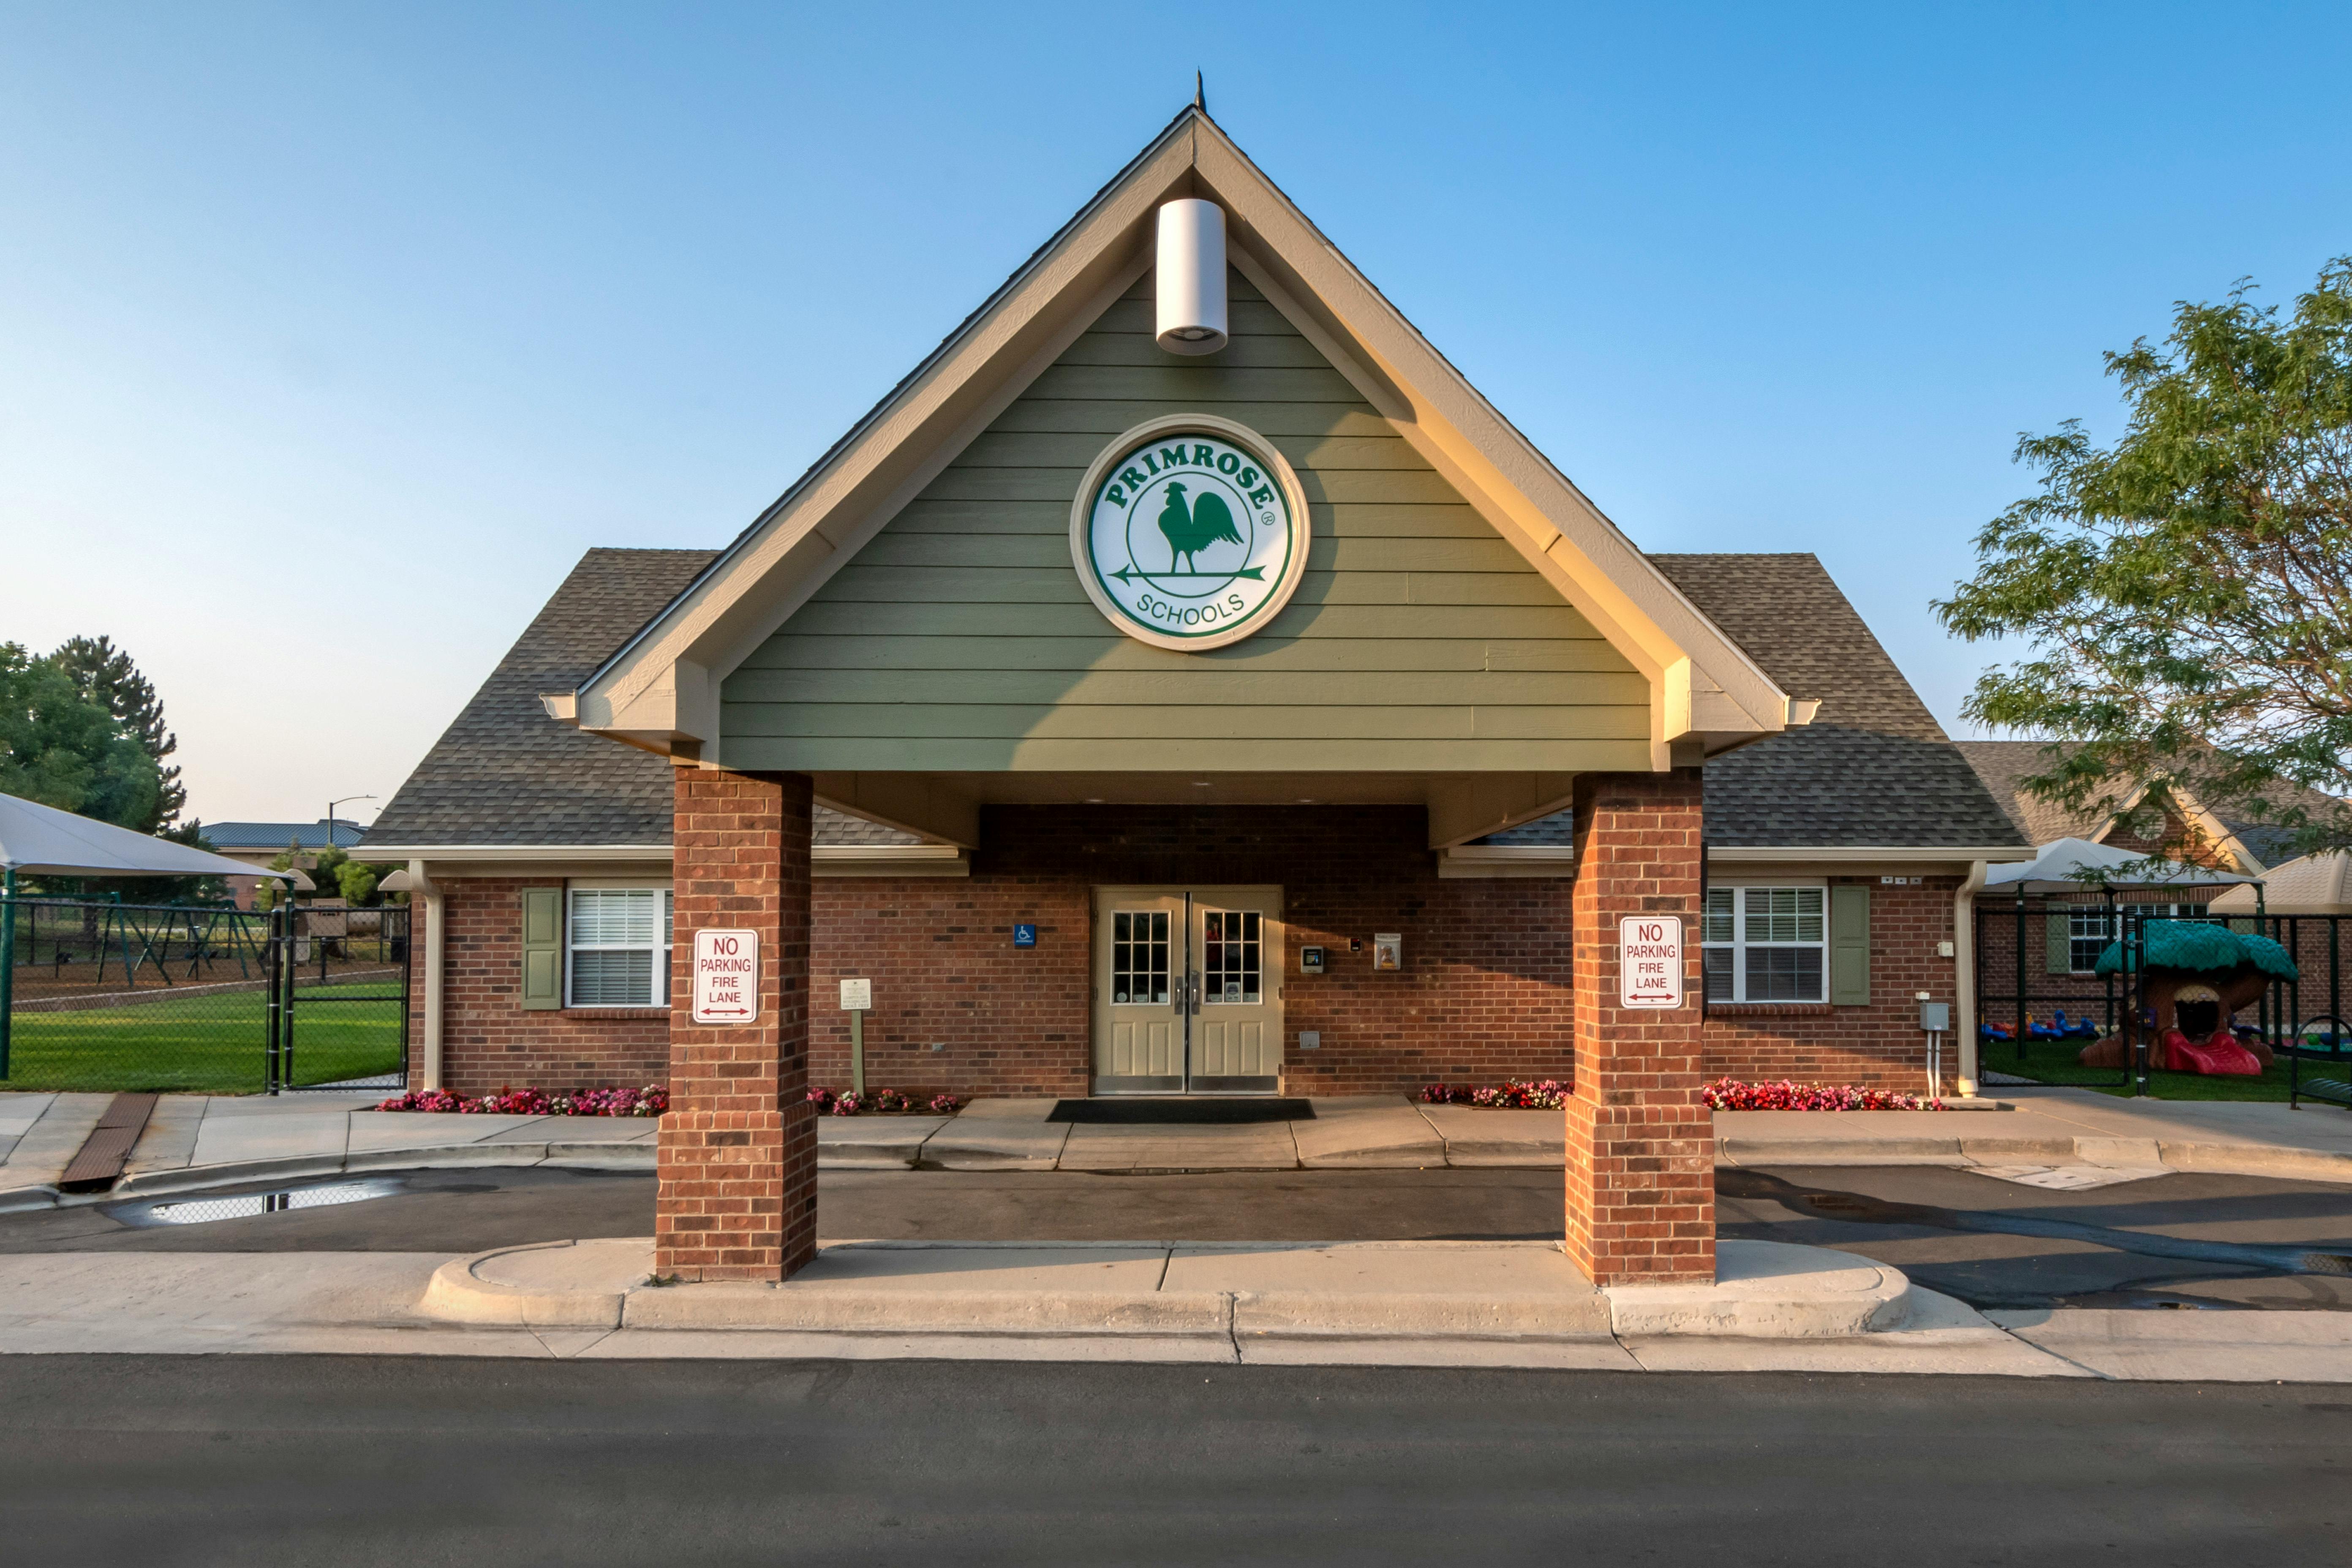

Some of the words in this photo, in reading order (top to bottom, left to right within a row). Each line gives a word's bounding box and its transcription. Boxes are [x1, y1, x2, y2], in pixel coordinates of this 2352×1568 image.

[1105, 444, 1275, 510] PRIMROSE
[1137, 593, 1244, 626] SCHOOLS
[1639, 924, 1663, 942] NO
[714, 937, 738, 955] NO
[1627, 945, 1675, 958] PARKING
[701, 958, 751, 972] PARKING
[1639, 963, 1664, 973] FIRE
[713, 977, 738, 988] FIRE
[1636, 978, 1667, 988] LANE
[709, 992, 741, 1003] LANE
